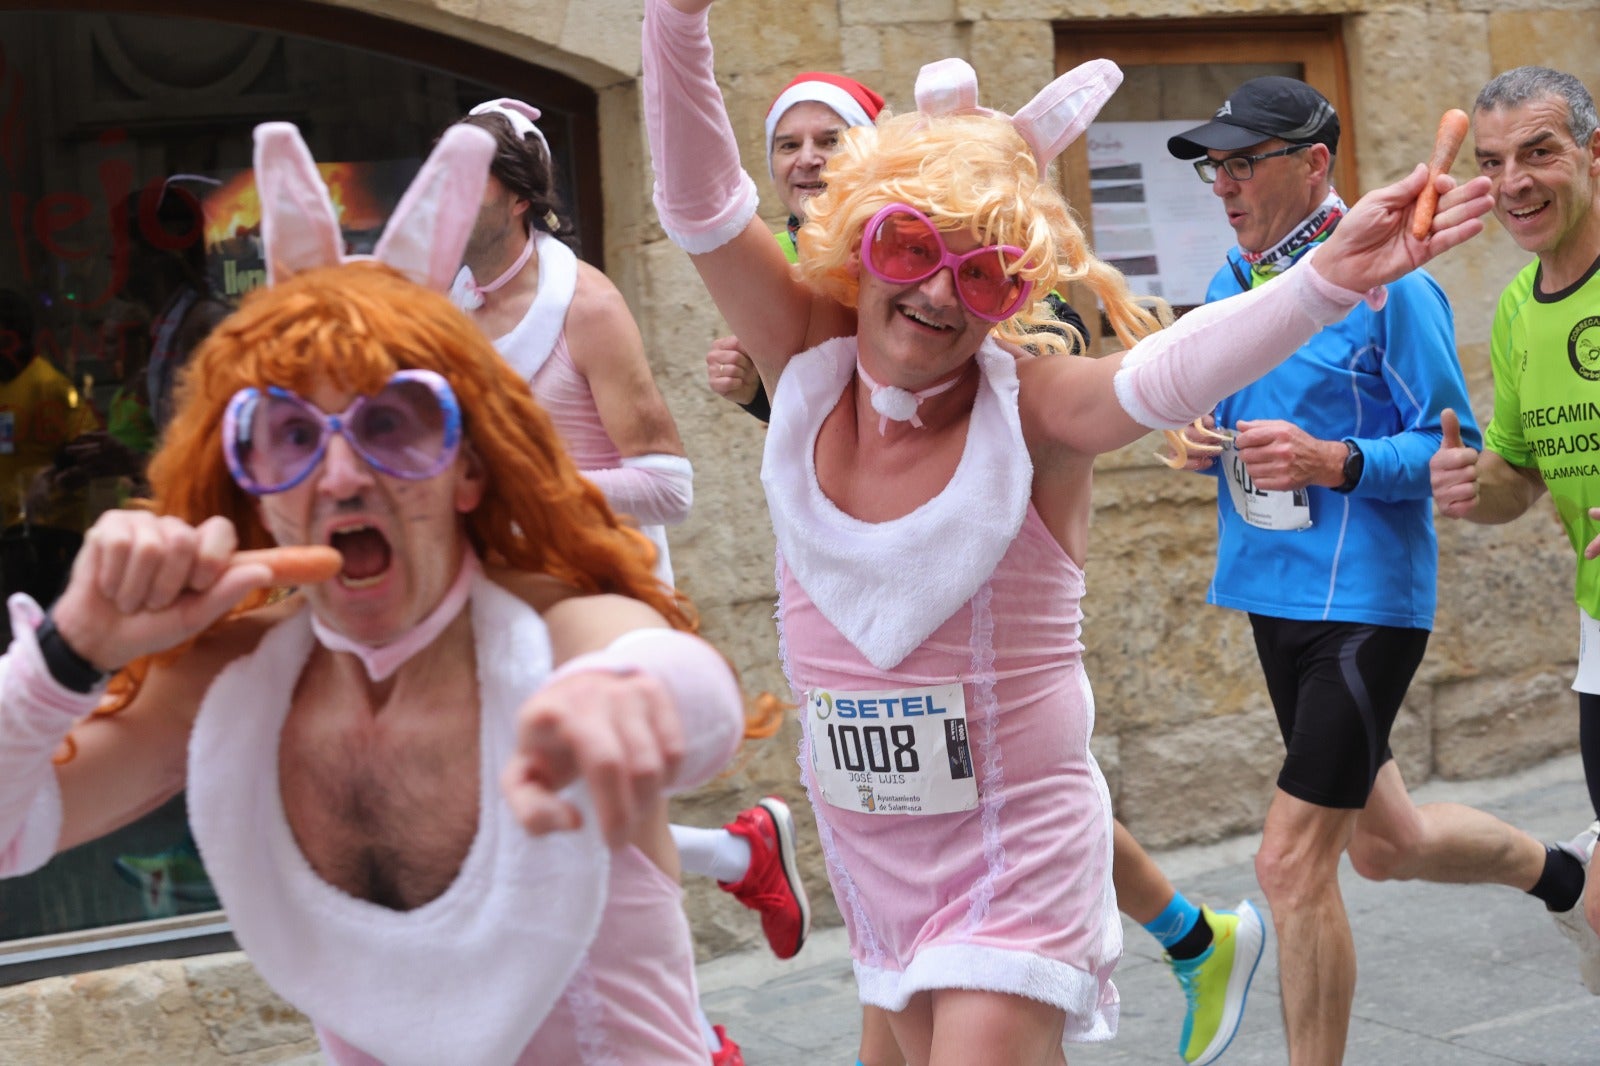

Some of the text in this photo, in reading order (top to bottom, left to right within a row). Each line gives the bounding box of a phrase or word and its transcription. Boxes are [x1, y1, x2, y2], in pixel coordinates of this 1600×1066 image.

[1541, 464, 1600, 481] ALAMANCA
[835, 695, 947, 719] SETEL
[828, 723, 920, 773] 1008
[849, 772, 906, 784] JOSÉ LUIS
[877, 794, 921, 803] Ayuntamiento
